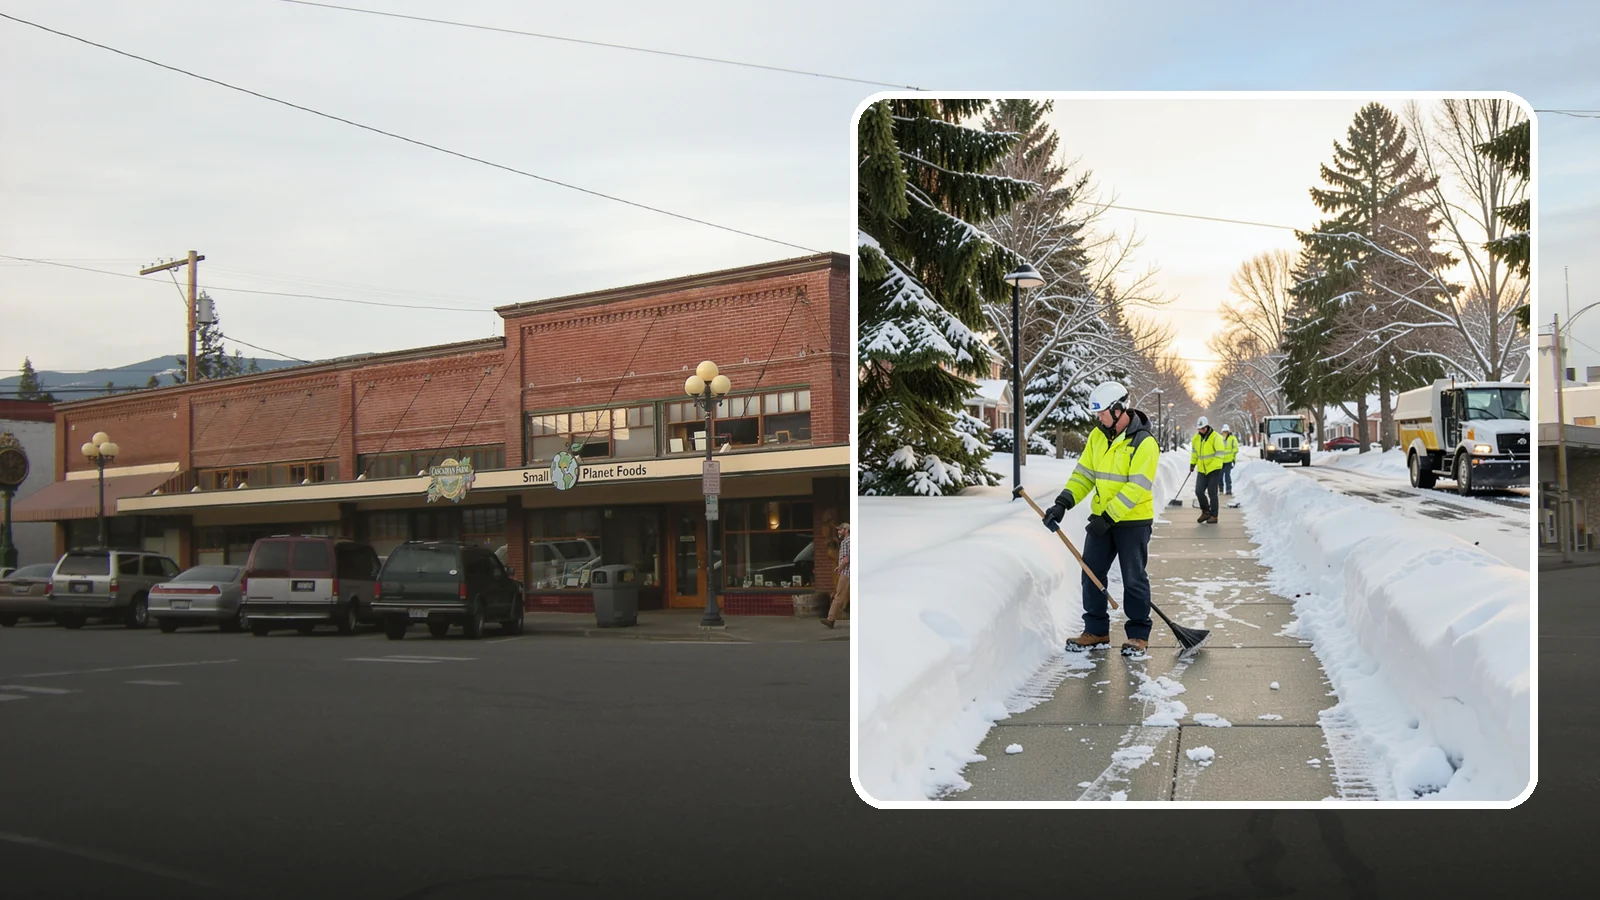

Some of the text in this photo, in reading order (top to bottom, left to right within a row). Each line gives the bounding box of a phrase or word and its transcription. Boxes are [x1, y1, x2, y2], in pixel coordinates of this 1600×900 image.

[523, 464, 647, 483] Small Planet Foods
